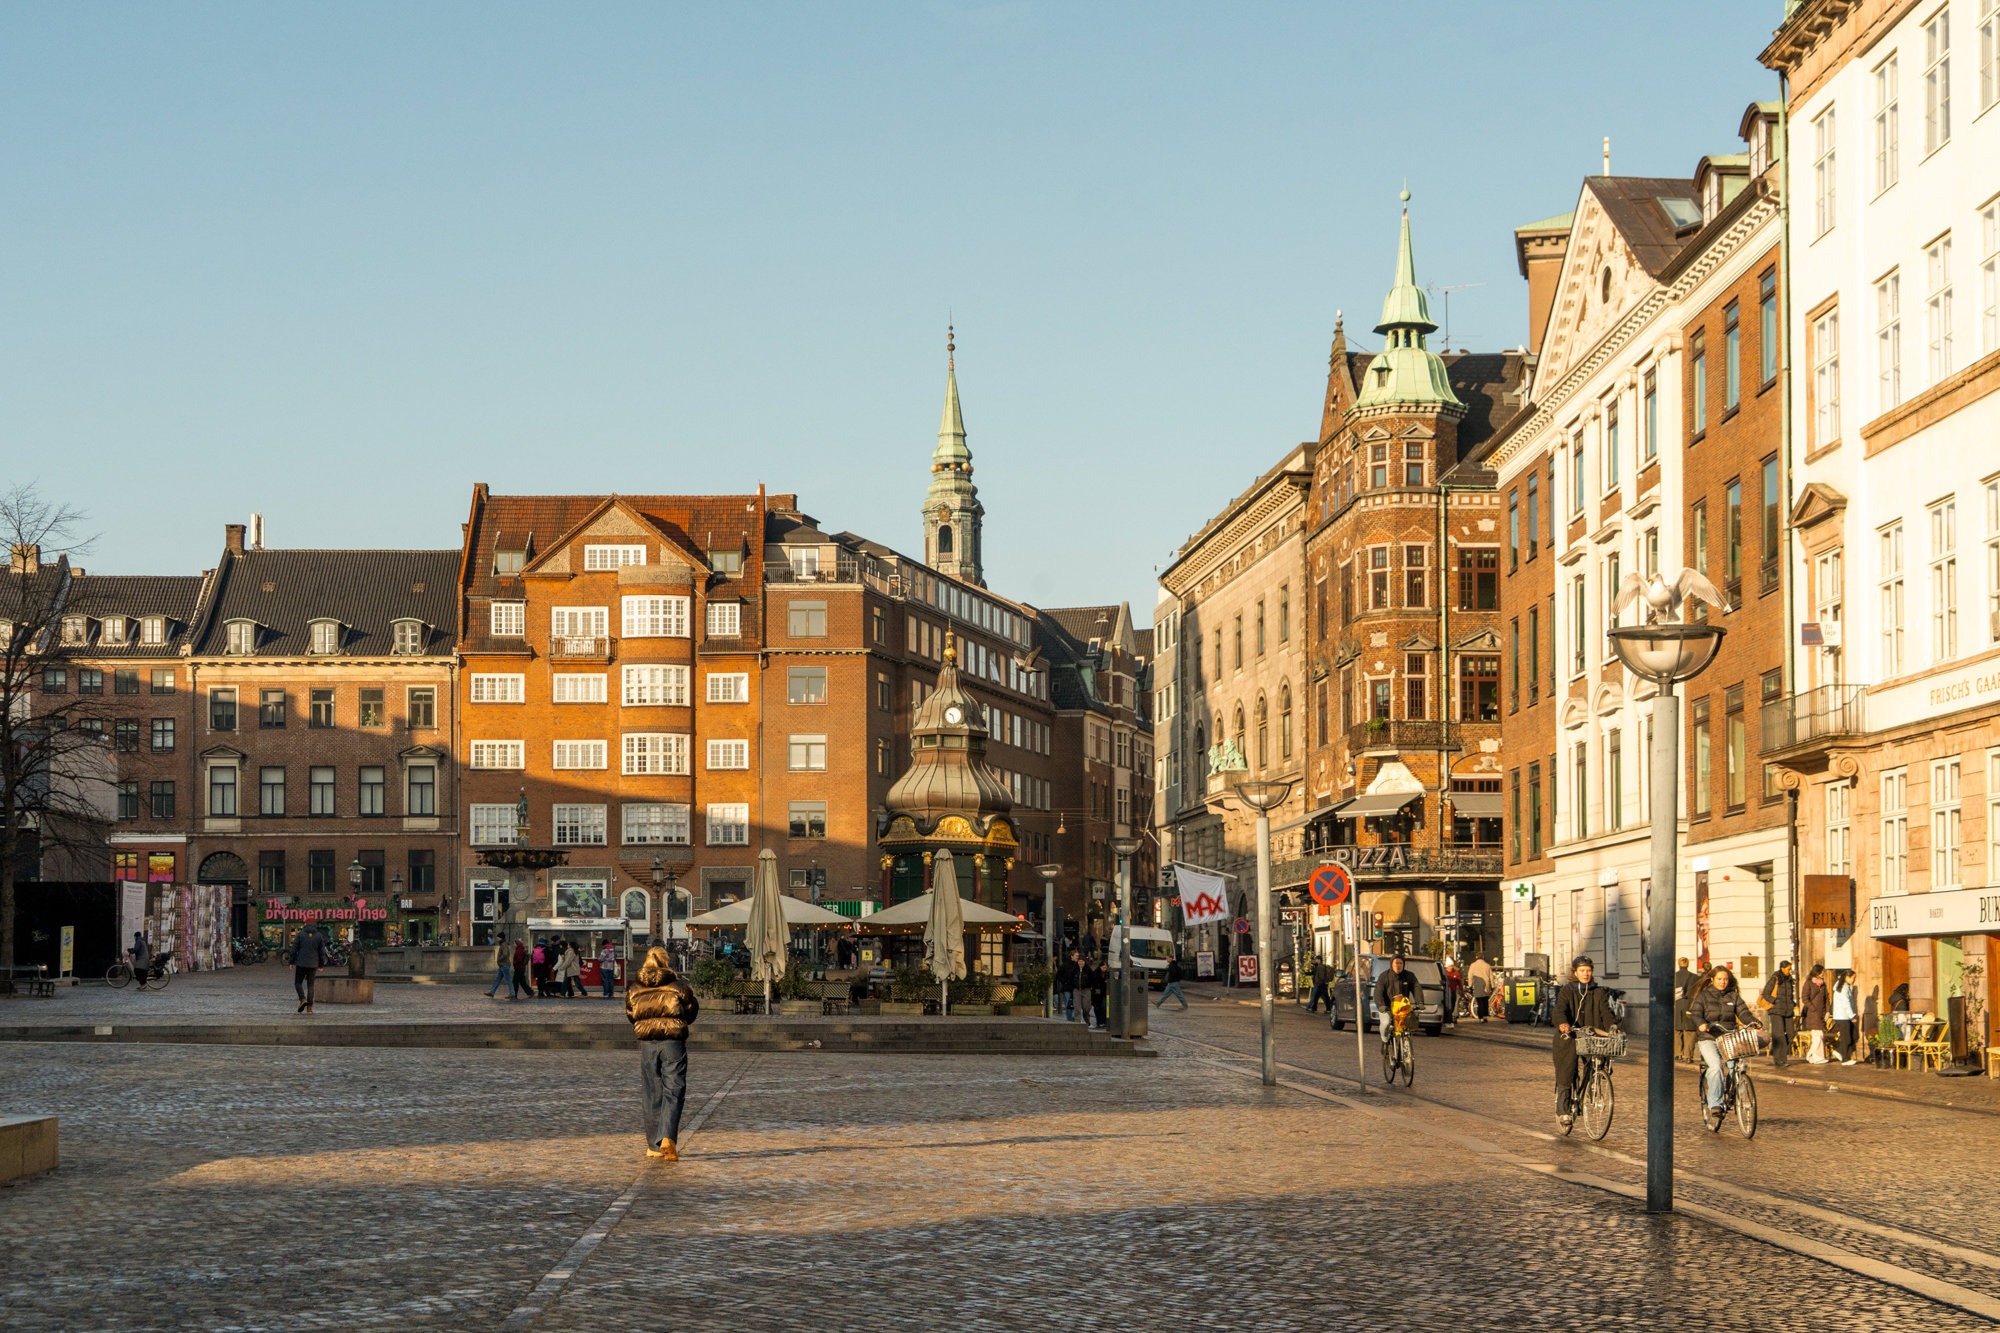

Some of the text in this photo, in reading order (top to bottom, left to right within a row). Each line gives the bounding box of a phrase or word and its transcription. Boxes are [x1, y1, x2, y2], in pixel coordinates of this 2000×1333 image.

[1336, 846, 1407, 869] PIZZA
[1185, 893, 1225, 919] MAX
[1873, 905, 1898, 930] BUKA
[1812, 912, 1847, 925] BUKA
[1240, 957, 1257, 977] 59
